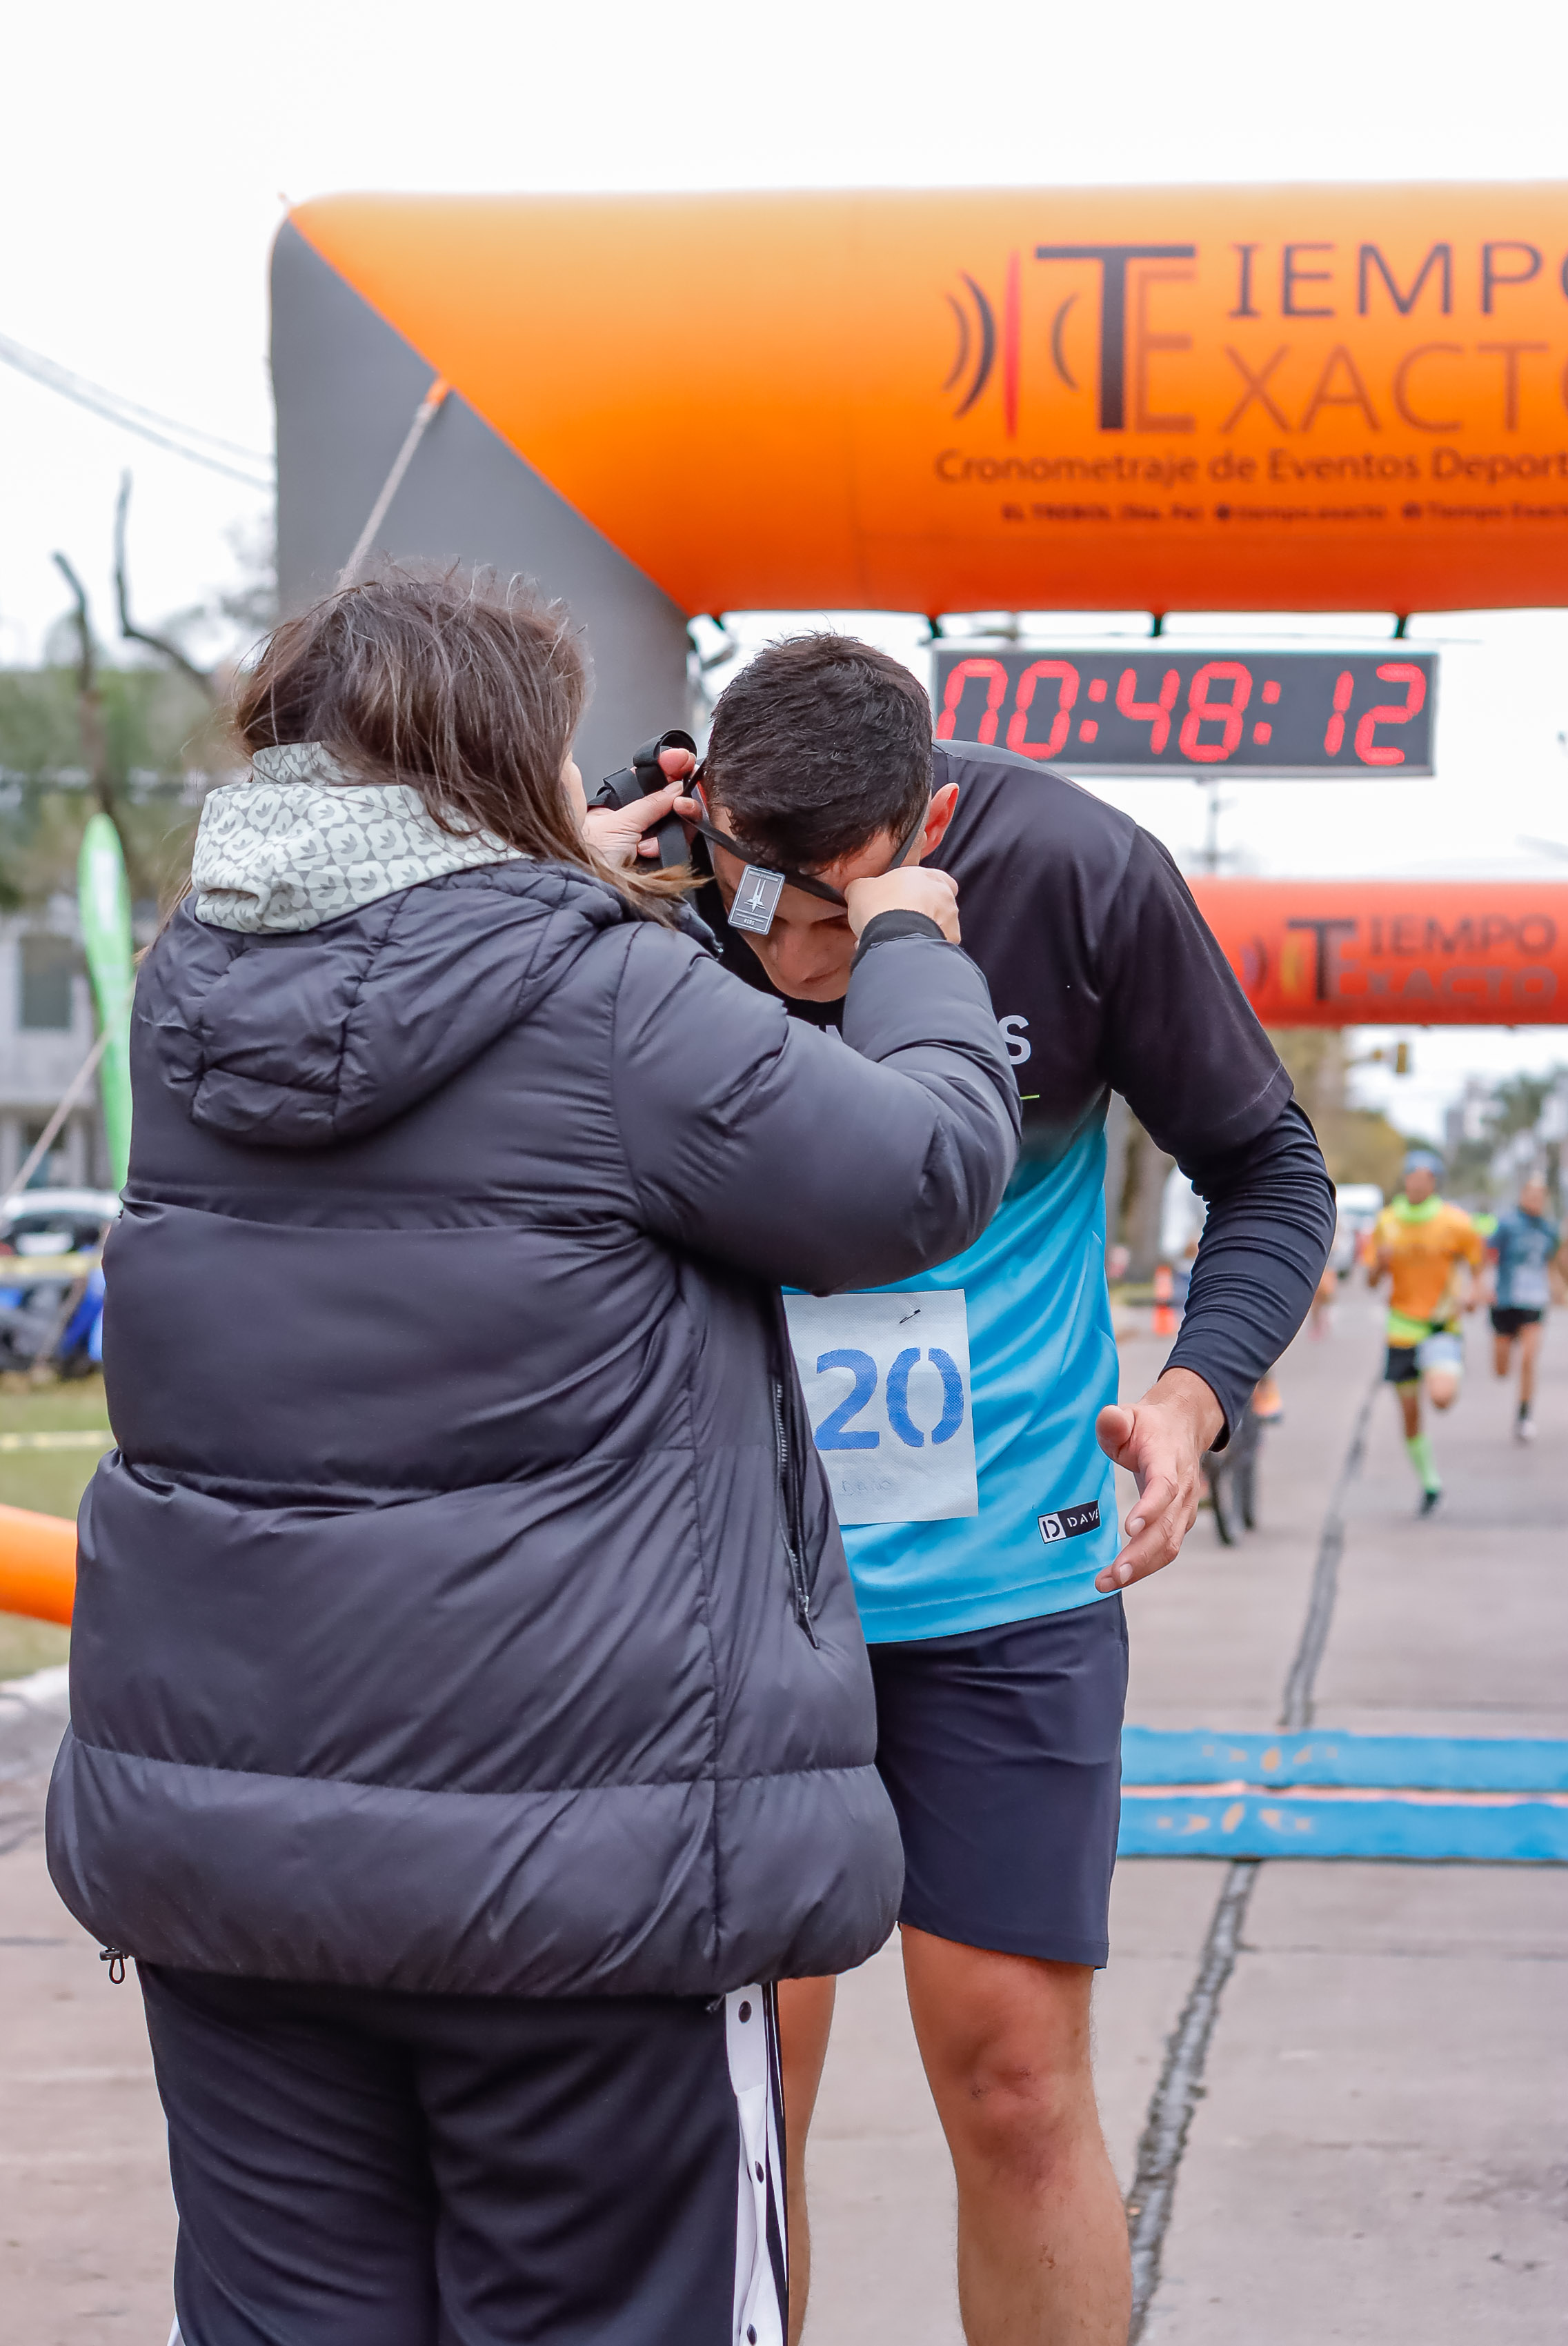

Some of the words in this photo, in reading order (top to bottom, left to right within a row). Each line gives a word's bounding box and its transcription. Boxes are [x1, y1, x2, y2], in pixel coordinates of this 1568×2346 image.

[1228, 240, 1568, 319] IEMP
[1218, 341, 1568, 435] XACT
[935, 447, 1199, 488] Cronometraje
[1207, 448, 1257, 481] de
[1268, 447, 1421, 481] Eventos
[813, 1347, 964, 1451] 20
